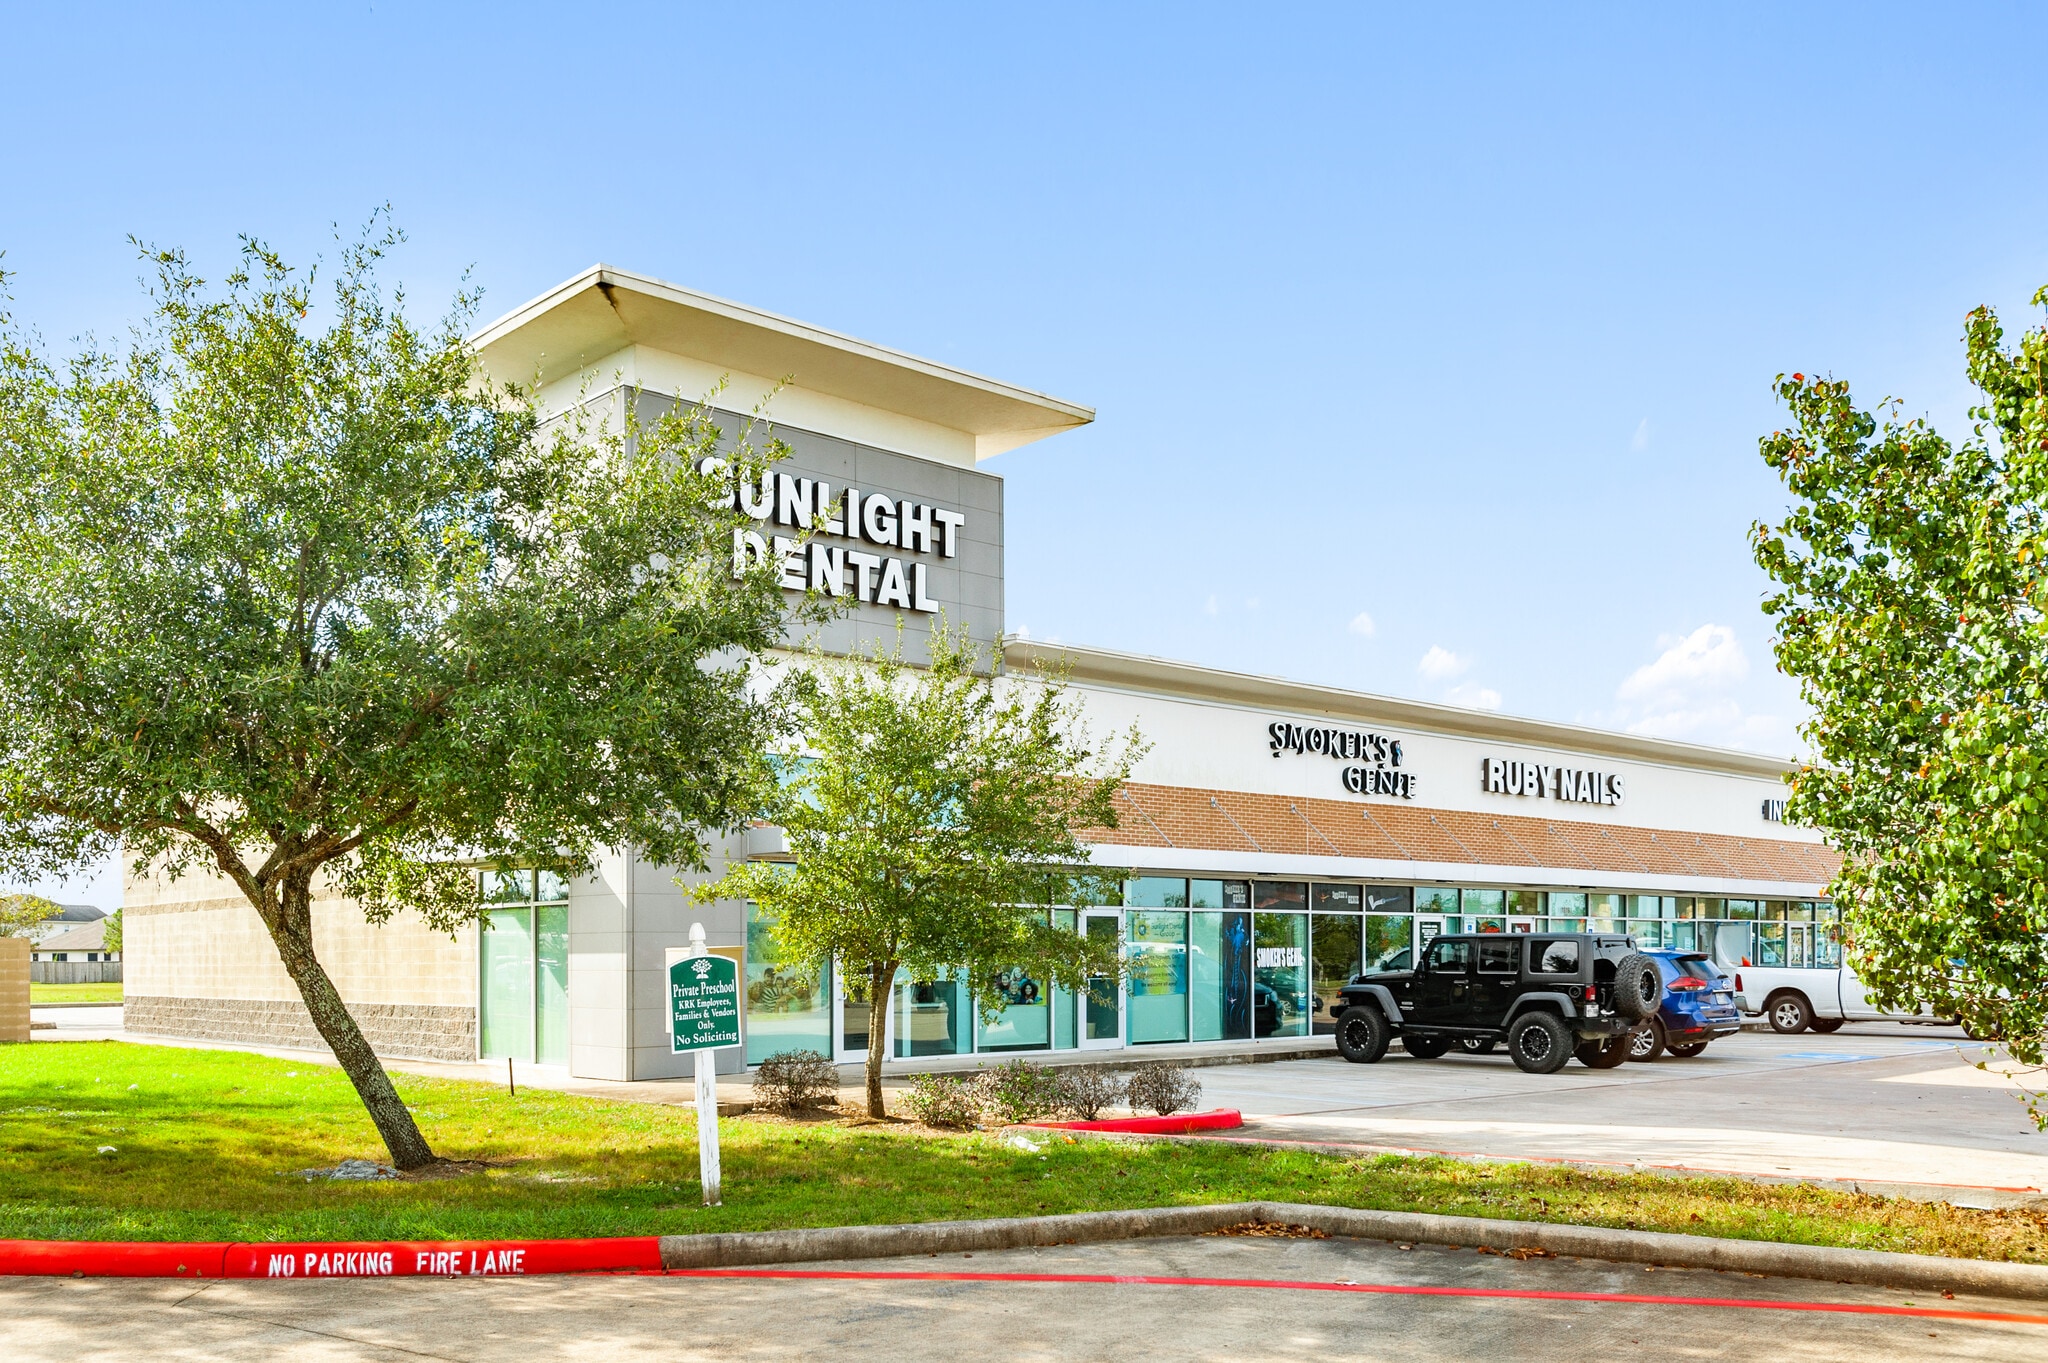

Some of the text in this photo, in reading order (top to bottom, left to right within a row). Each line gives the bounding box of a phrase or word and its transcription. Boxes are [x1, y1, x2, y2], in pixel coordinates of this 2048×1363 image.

[697, 456, 965, 558] SUNLIGHT
[733, 527, 940, 614] DENTAL
[1269, 722, 1390, 765] SMOKER'S
[1342, 766, 1417, 799] GENIE
[1484, 758, 1625, 806] RUBY NAILS
[1256, 947, 1286, 967] SMOKER'S
[673, 979, 735, 998] Private Preschool
[675, 1007, 736, 1021] Families & Vendors
[678, 997, 731, 1010] KRK Employees,
[697, 1020, 715, 1030] Only.
[676, 1030, 737, 1046] No Soliciting
[268, 1250, 526, 1277] NO PARKING FIRE LANE
